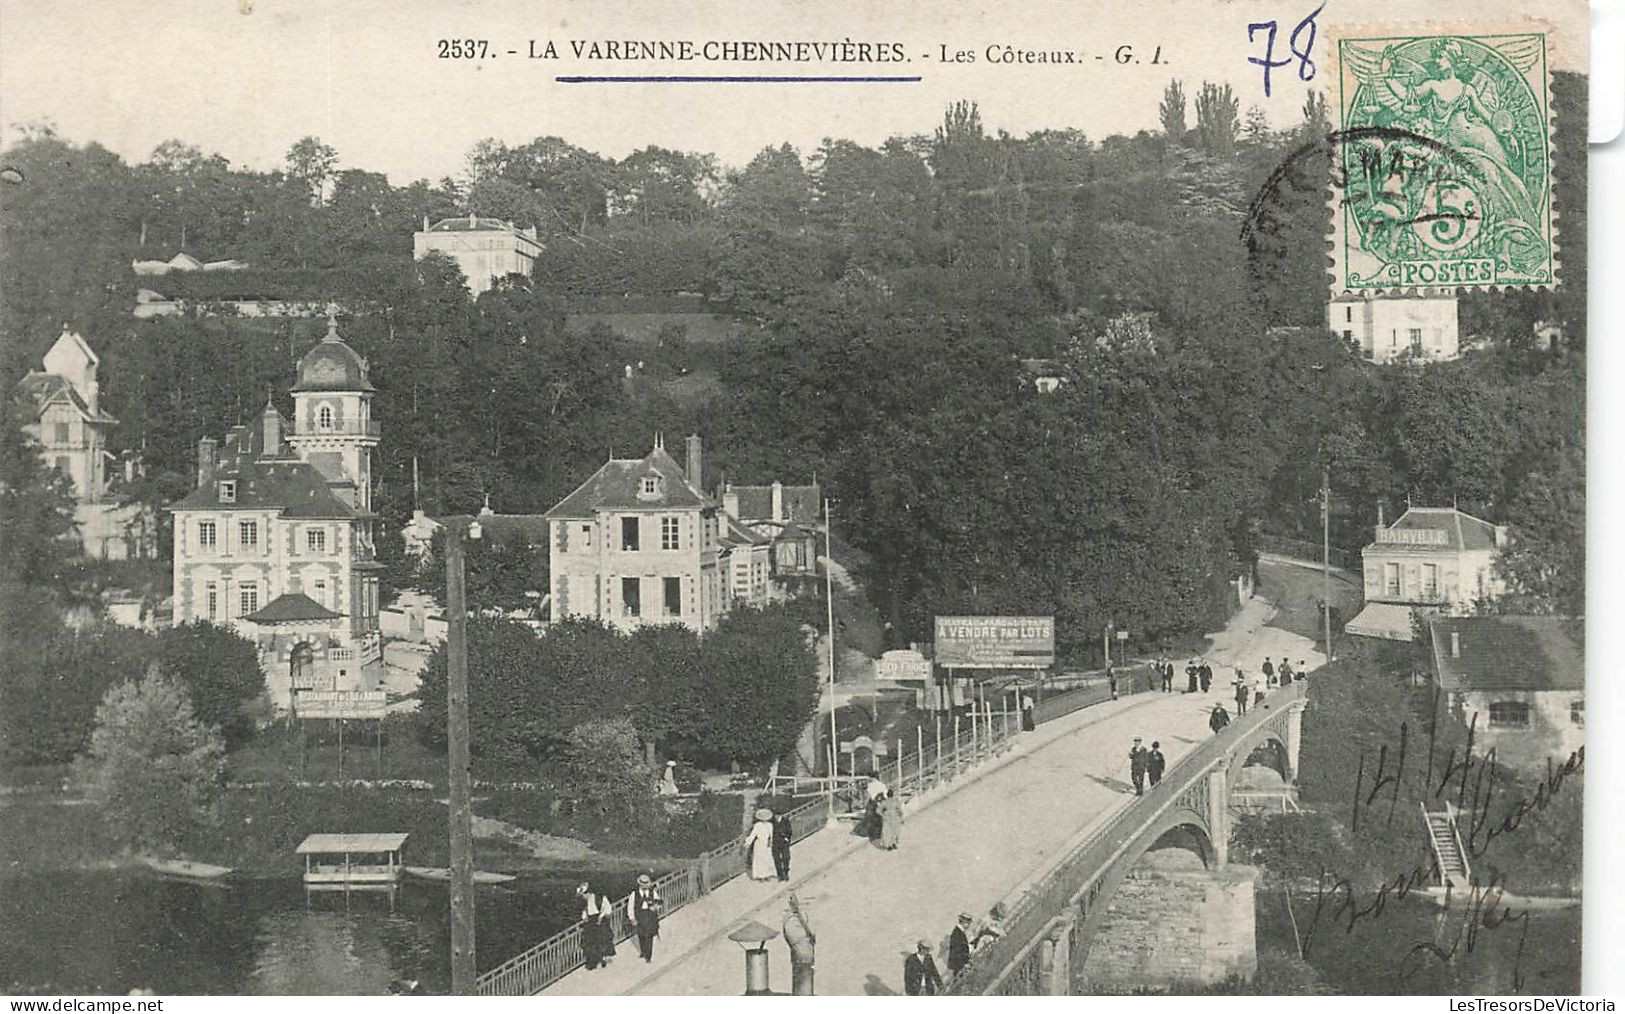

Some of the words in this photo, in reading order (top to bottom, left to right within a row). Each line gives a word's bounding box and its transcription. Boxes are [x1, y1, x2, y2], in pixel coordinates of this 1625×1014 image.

[437, 40, 497, 59] 2537.
[529, 40, 560, 59] LA
[570, 38, 911, 63] VARENNE-CHENNEVIÈRES.
[941, 44, 976, 63] Les
[985, 44, 1083, 64] Côteaux.
[1115, 45, 1140, 65] G.
[1247, 2, 1324, 97] 78
[1403, 262, 1492, 284] POSTES
[949, 626, 997, 638] VENDRE
[1001, 628, 1018, 638] PAR
[1021, 626, 1050, 638] LOTS
